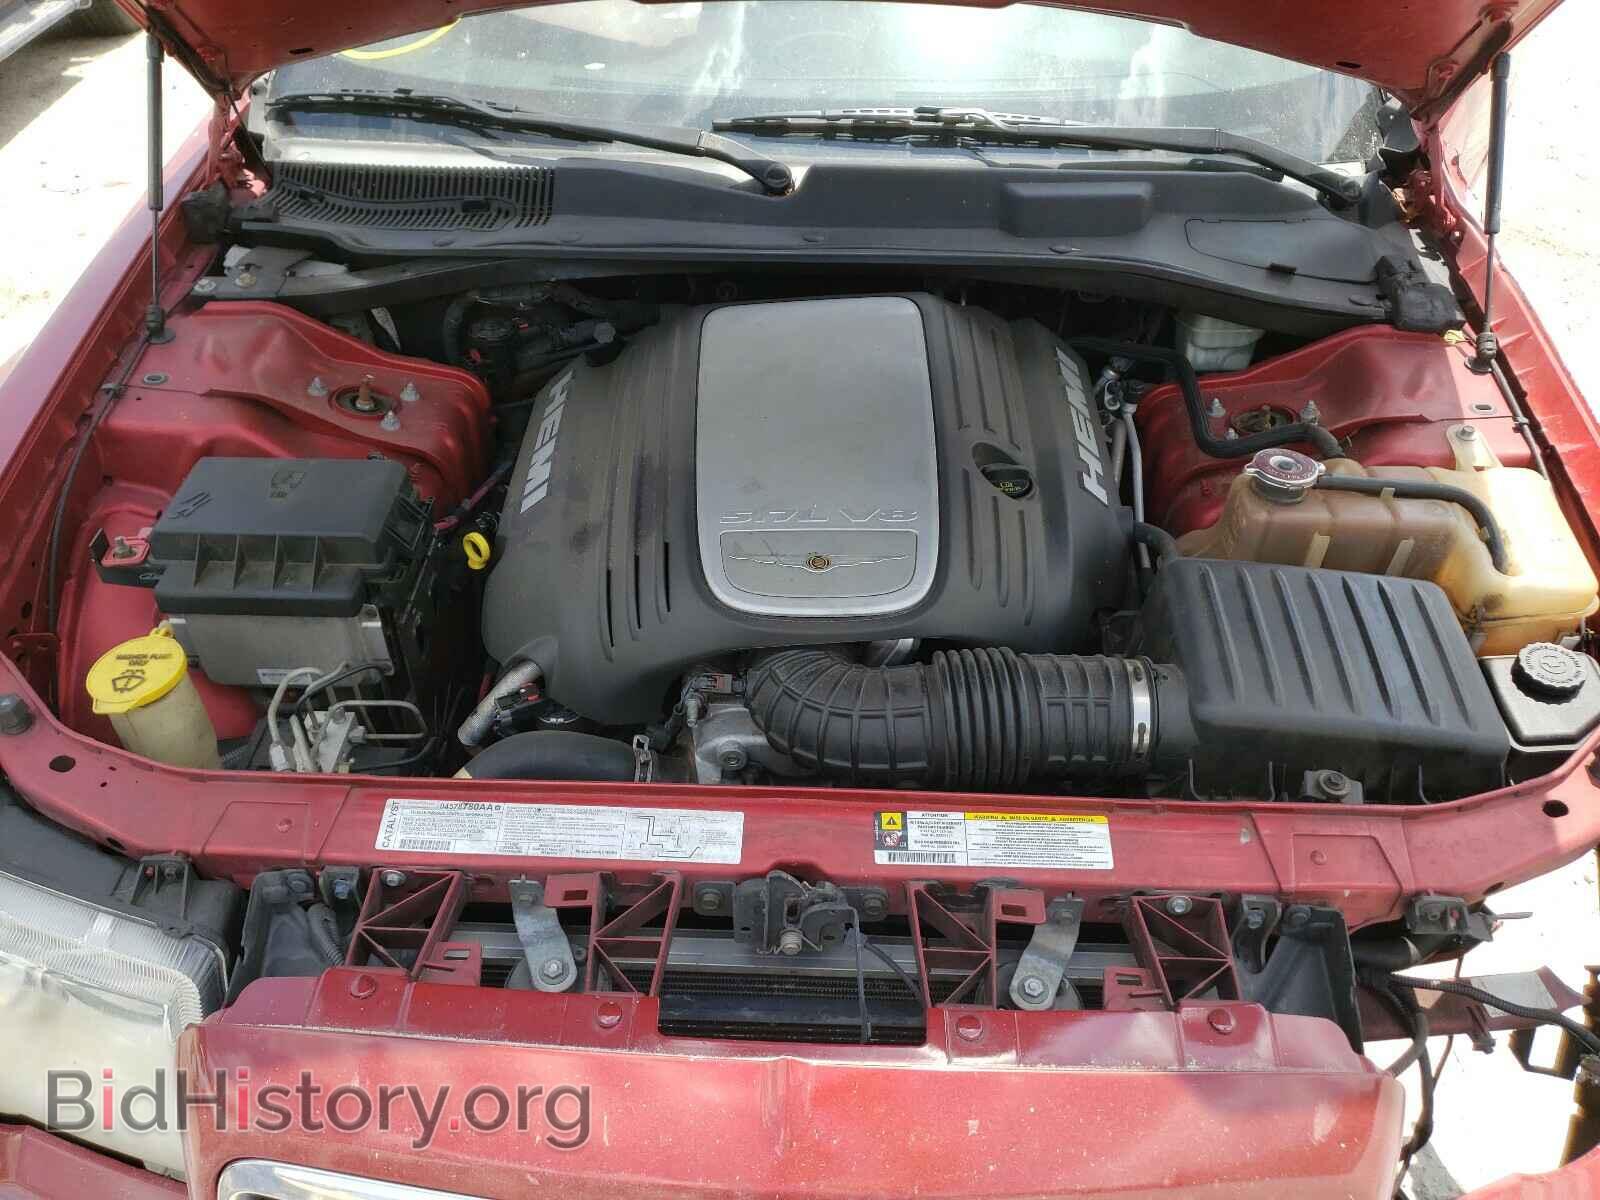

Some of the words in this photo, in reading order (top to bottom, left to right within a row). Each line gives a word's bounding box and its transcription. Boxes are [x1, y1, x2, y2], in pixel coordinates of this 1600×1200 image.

[520, 369, 574, 515] HEMI
[1055, 346, 1109, 506] HEMI
[382, 800, 400, 848] CATALYST
